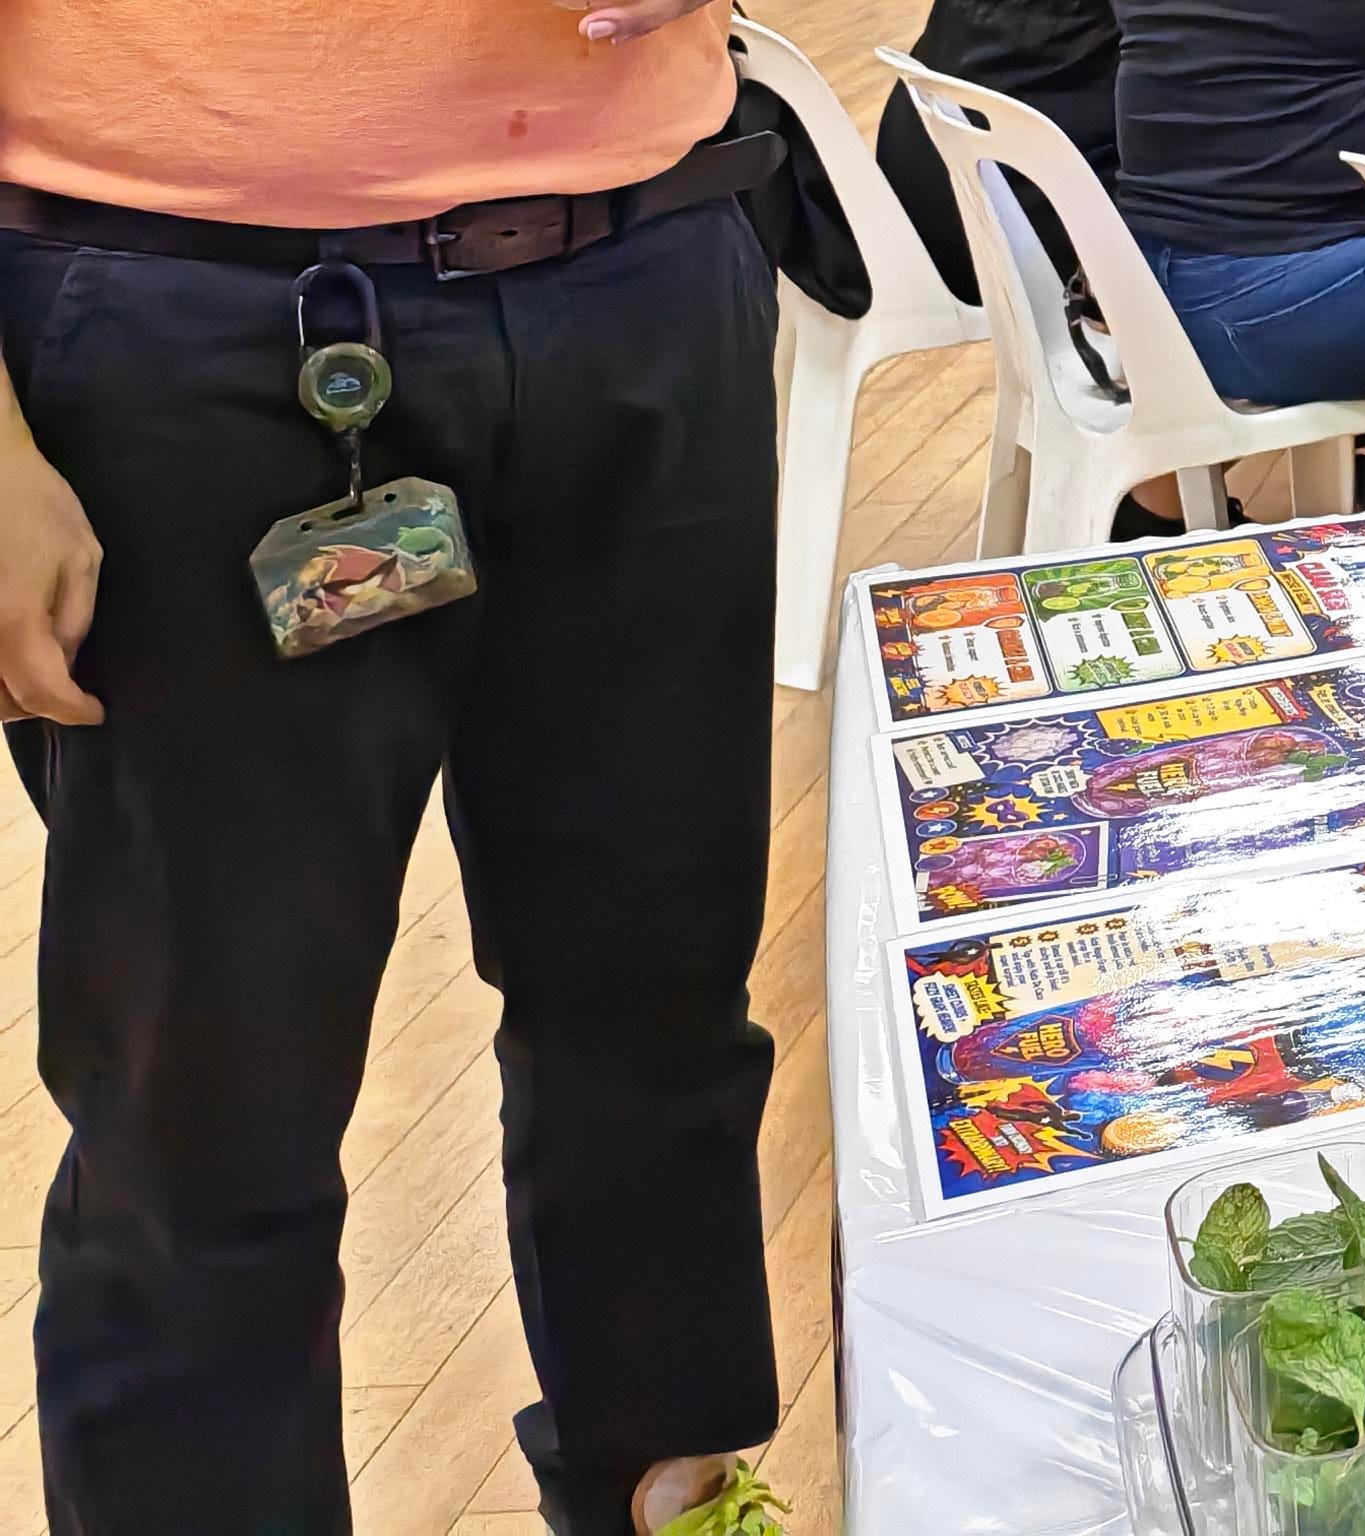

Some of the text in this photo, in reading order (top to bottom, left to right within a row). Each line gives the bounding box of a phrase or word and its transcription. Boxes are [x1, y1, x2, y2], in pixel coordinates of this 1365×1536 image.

[926, 885, 980, 910] POW!
[1013, 1029, 1046, 1061] FUEL
[1032, 1021, 1070, 1060] HERO
